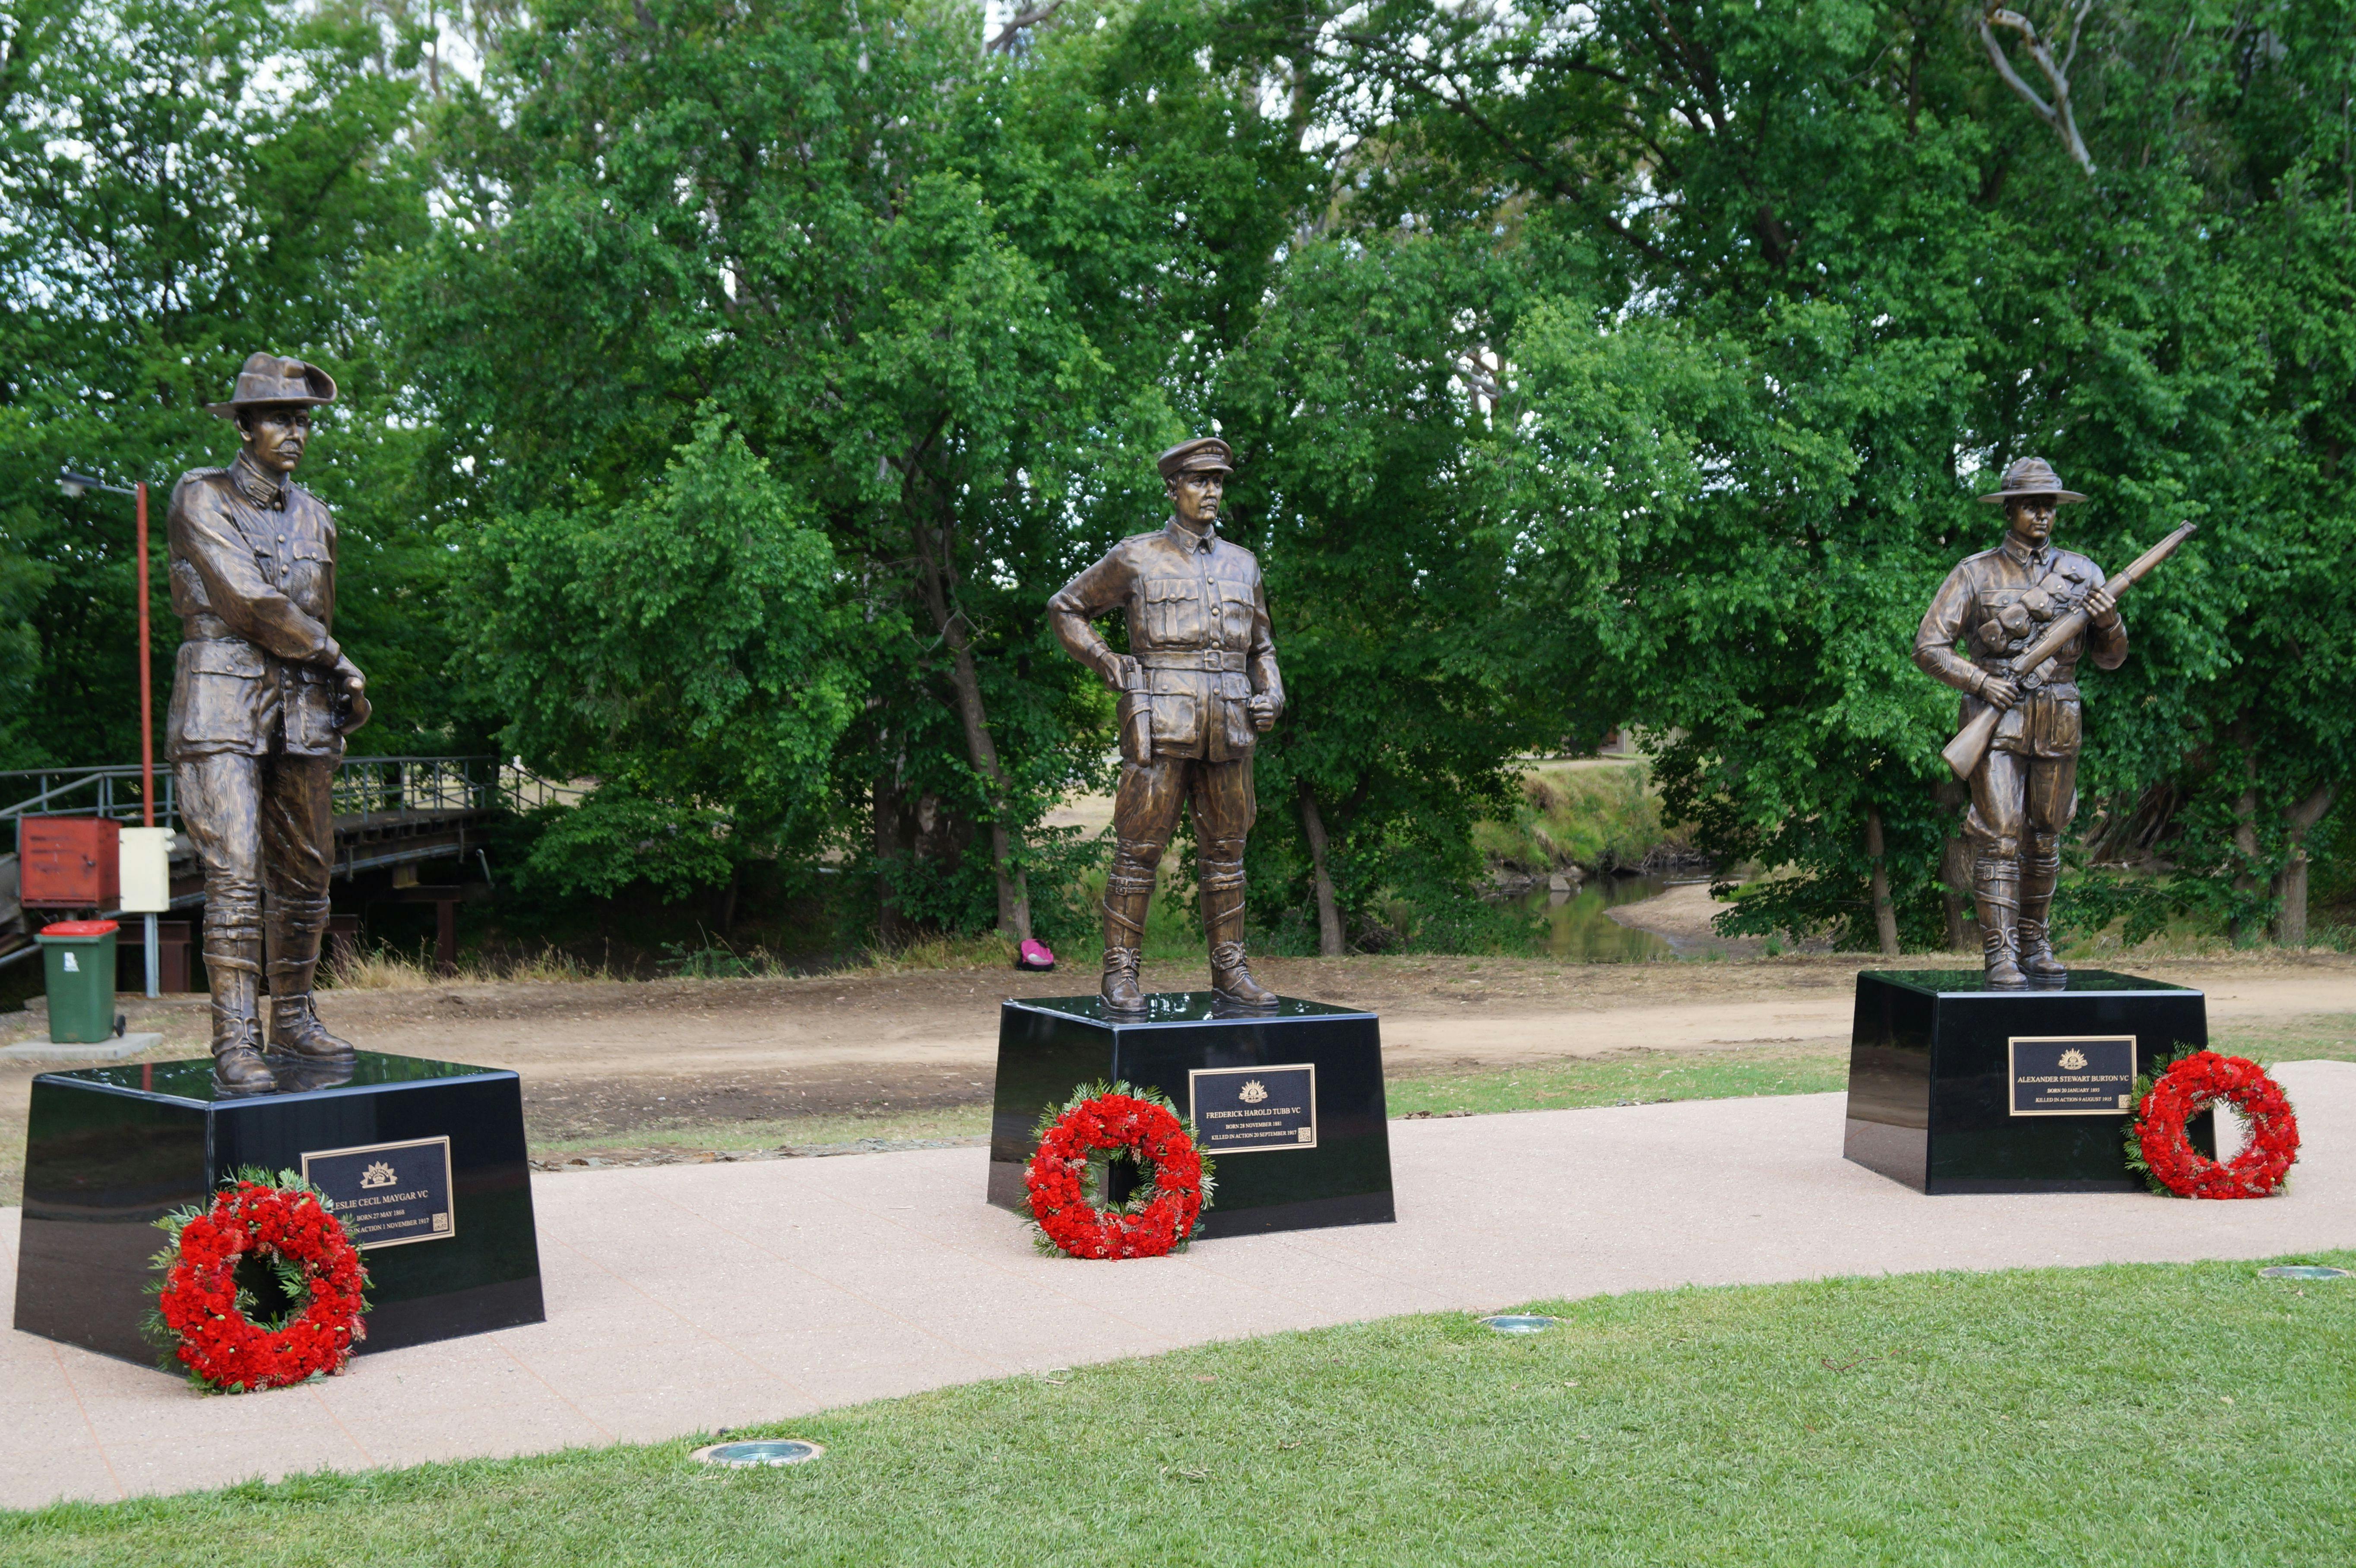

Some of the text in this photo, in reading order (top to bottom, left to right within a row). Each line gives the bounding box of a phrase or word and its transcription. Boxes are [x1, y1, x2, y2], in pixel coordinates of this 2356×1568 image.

[1206, 1110, 1243, 1119] FREDERICK
[358, 1197, 382, 1207] CECIL
[382, 1192, 417, 1203] MAYGAR
[417, 1190, 428, 1198] VC
[361, 1224, 382, 1233] ACTION
[386, 1219, 418, 1229] NOVEMBER
